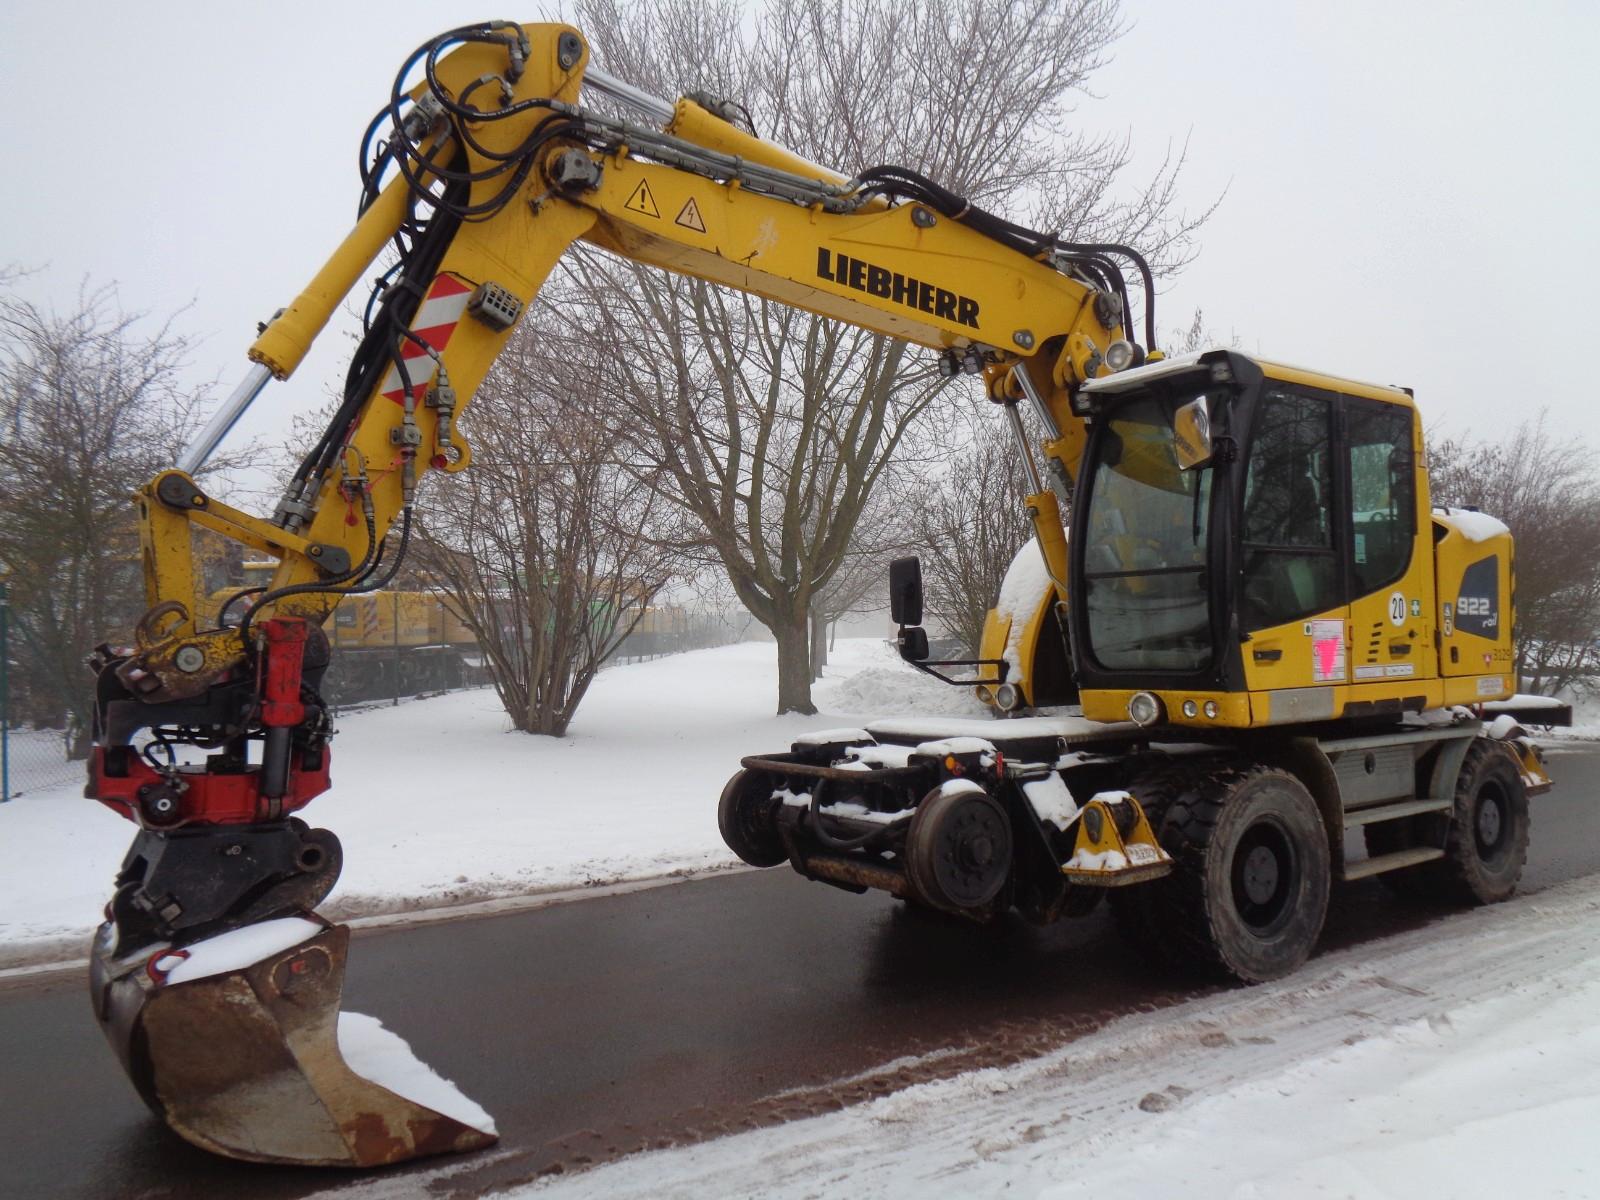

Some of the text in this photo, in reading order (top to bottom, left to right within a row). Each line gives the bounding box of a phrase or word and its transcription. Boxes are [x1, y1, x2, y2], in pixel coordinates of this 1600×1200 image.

[817, 246, 981, 329] LIEBHERR
[1392, 597, 1404, 619] 20
[1457, 597, 1490, 615] 922
